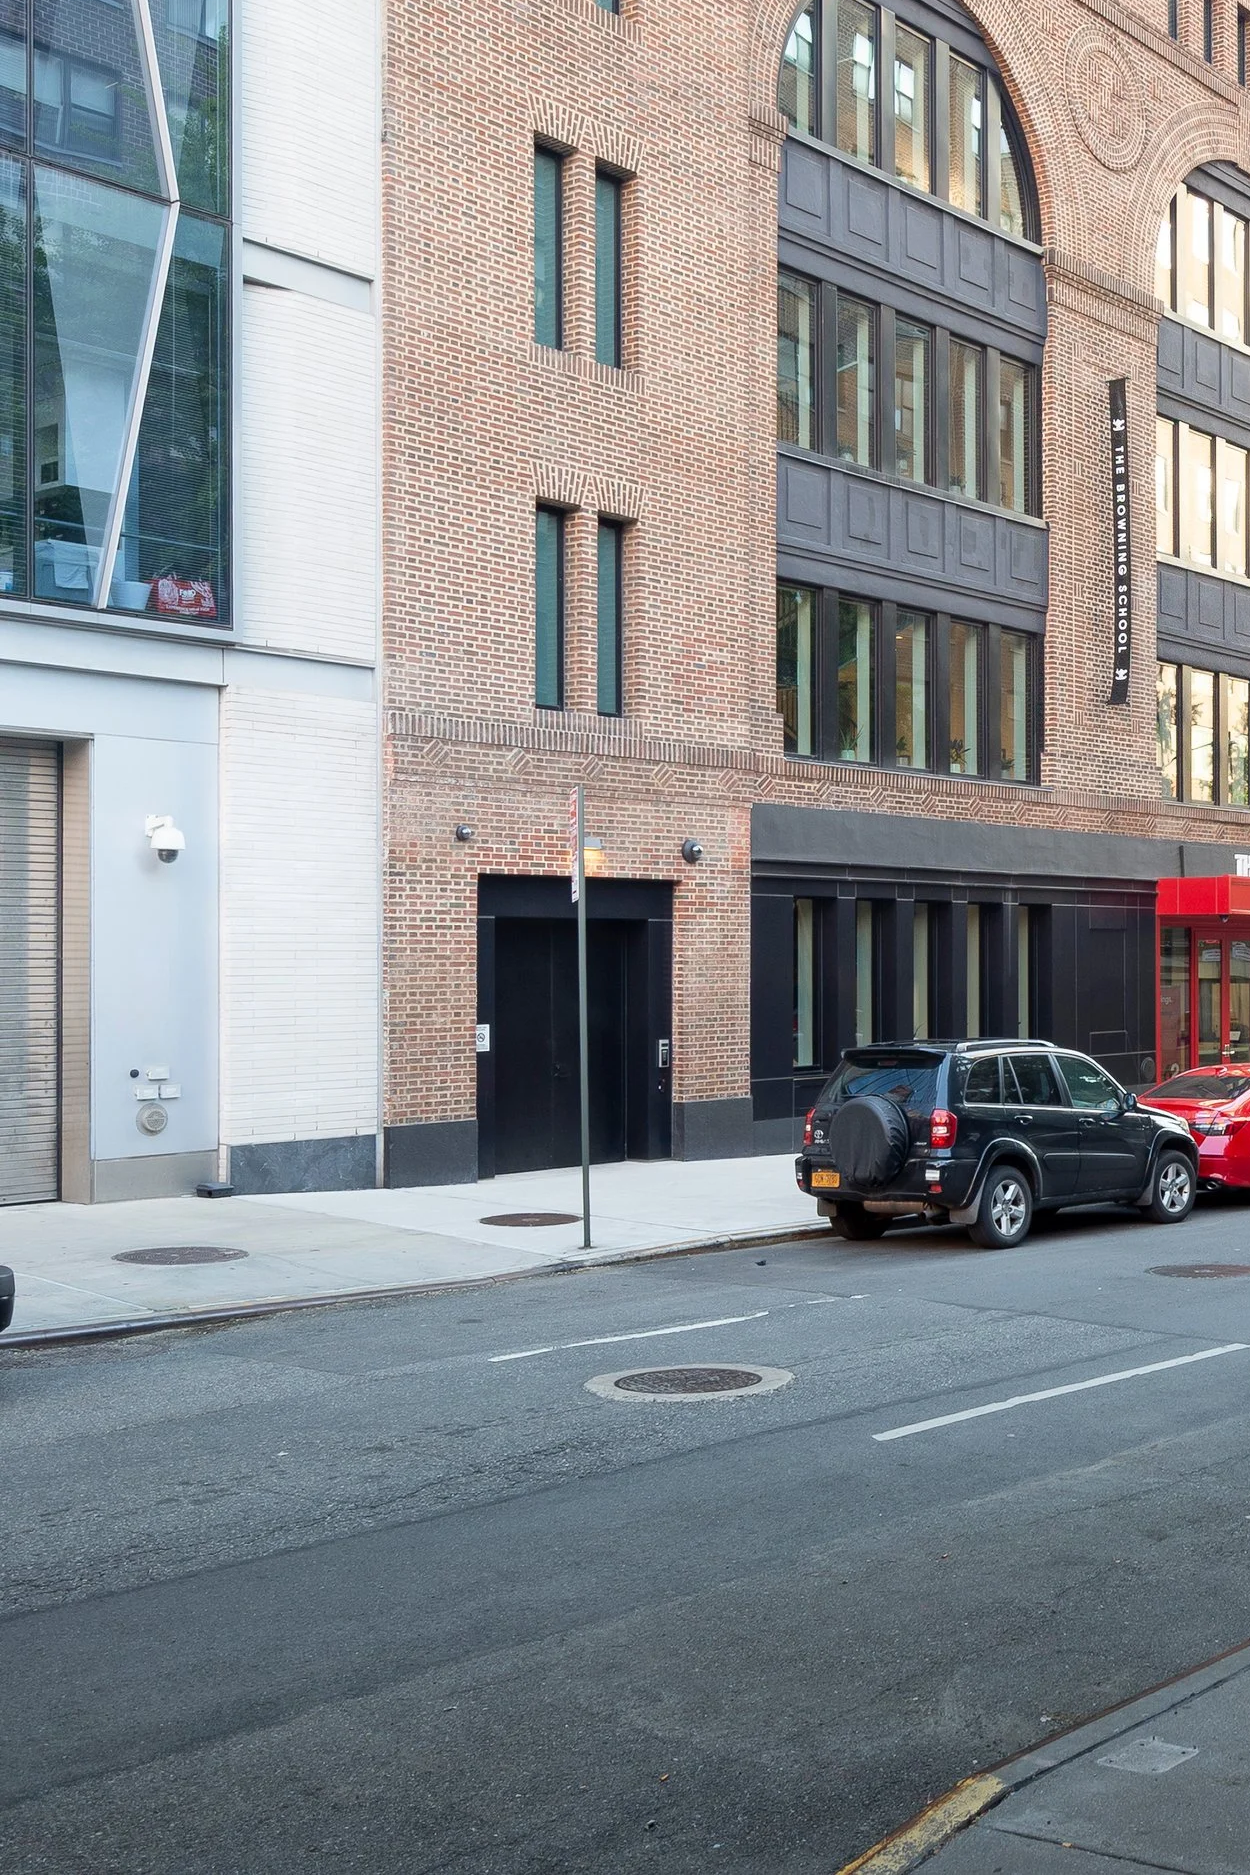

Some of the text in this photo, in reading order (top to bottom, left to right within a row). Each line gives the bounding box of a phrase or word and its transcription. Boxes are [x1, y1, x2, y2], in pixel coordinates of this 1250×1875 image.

[1114, 445, 1128, 654] THE BROWNING SCHOOL
